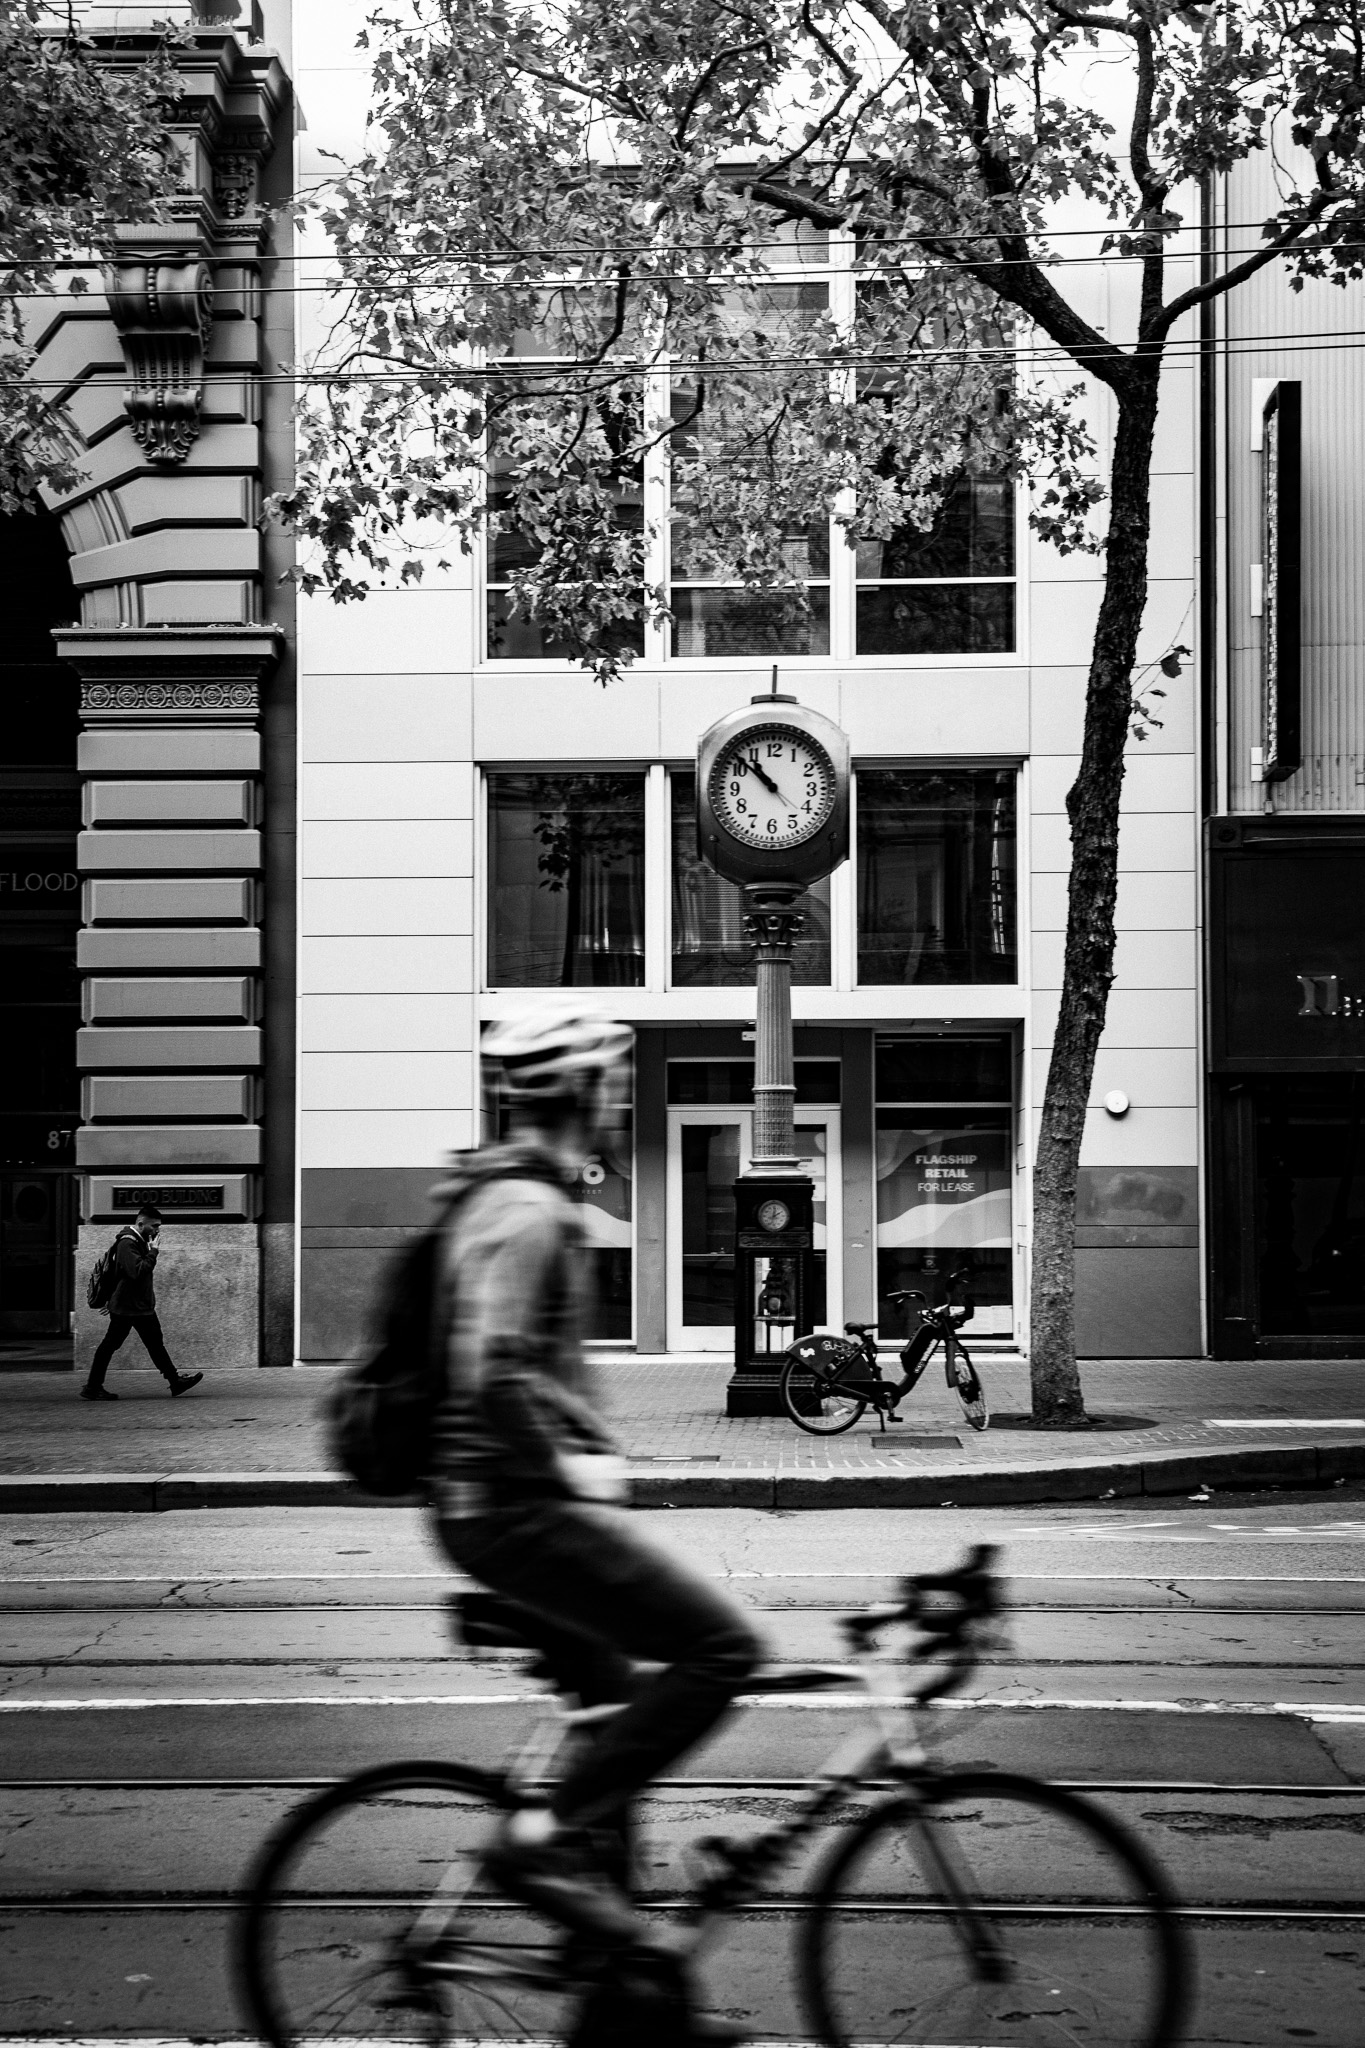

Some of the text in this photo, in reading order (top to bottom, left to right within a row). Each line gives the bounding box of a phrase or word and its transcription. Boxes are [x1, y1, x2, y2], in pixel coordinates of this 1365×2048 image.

[749, 748, 759, 762] 11
[767, 743, 782, 757] 12
[790, 749, 796, 762] 1
[733, 762, 748, 777] 10
[803, 763, 814, 777] 2
[730, 782, 740, 796] 9
[806, 782, 817, 797] 3
[736, 798, 747, 813] 8
[800, 800, 812, 814] 4
[748, 814, 758, 828] 7
[767, 819, 777, 834] 6
[787, 814, 798, 829] 5
[0, 872, 78, 891] FLOOD
[47, 1130, 76, 1149] 87
[915, 1155, 978, 1164] FLAGSHIP
[925, 1168, 968, 1178] RETAIL
[917, 1182, 976, 1192] FOR LEASE
[116, 1189, 219, 1204] FLOOD BUILDING
